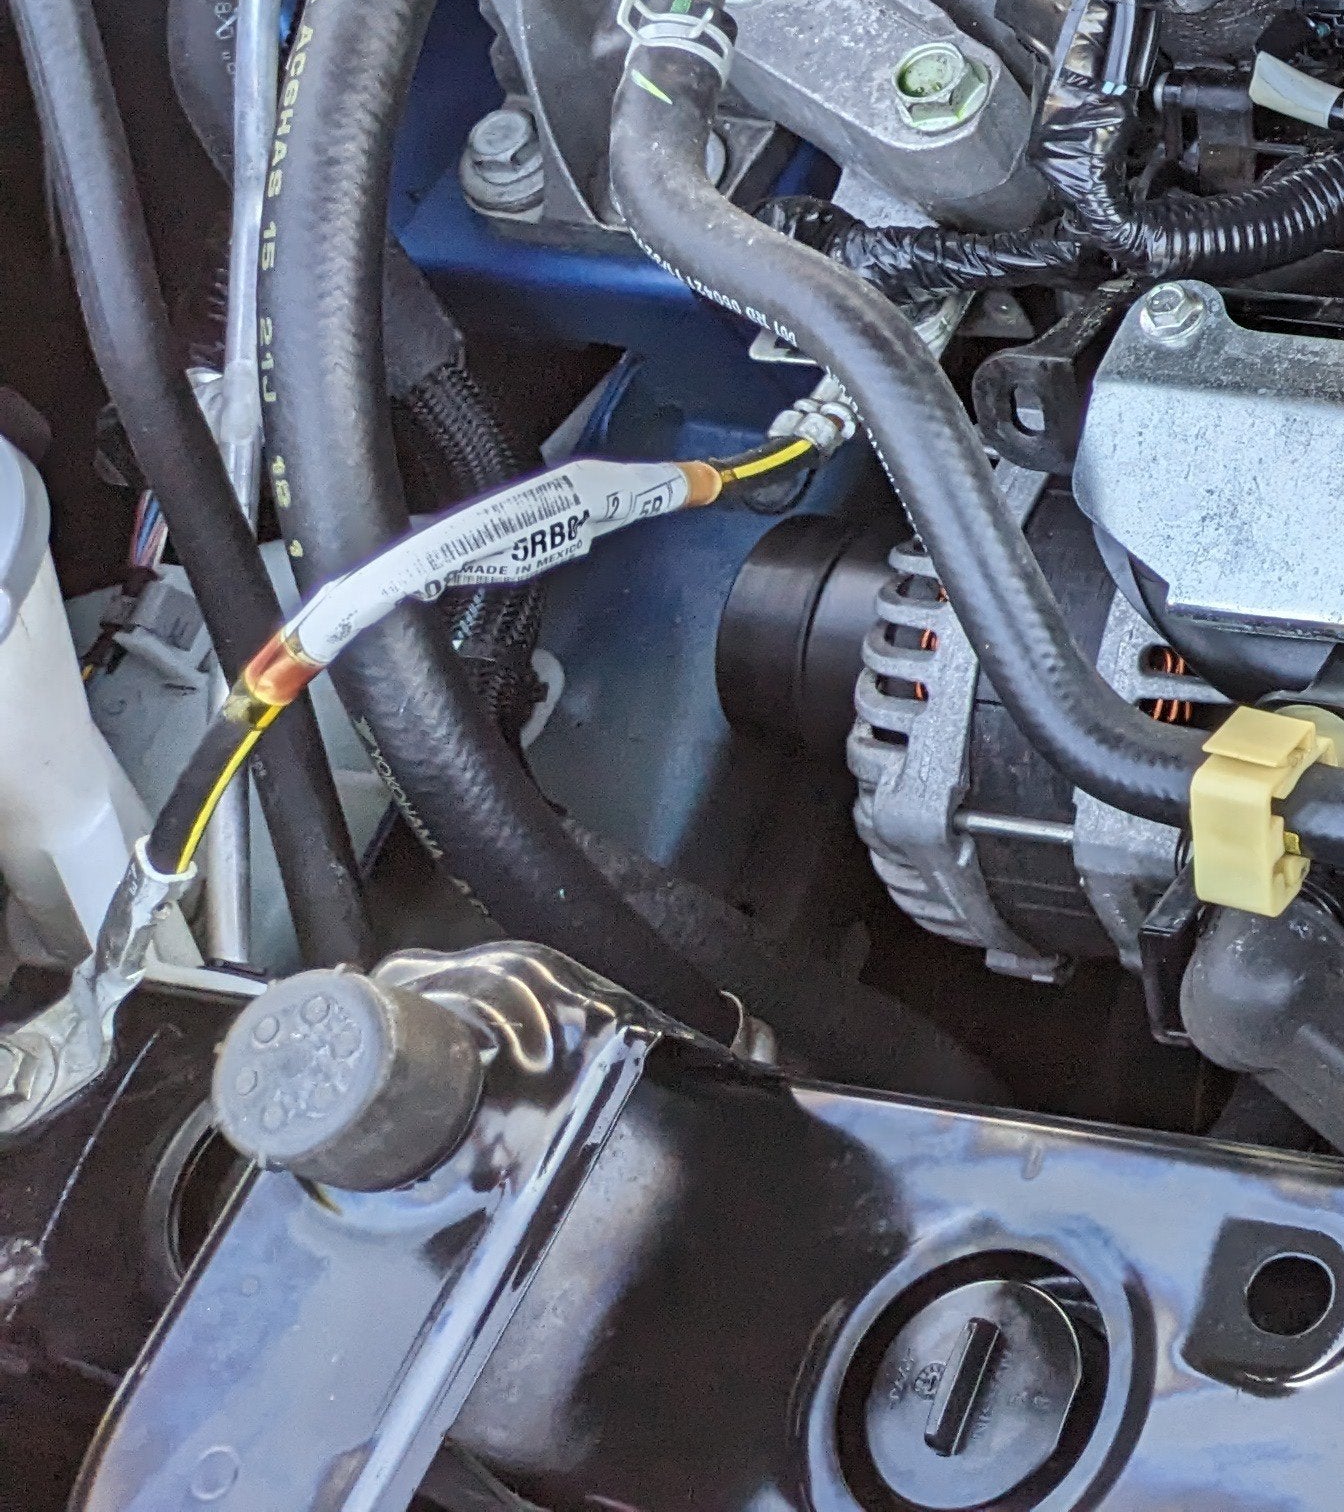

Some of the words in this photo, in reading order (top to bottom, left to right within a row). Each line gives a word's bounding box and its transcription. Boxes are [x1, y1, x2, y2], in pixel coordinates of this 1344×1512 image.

[460, 563, 508, 575] MADE
[515, 563, 532, 575] IN
[536, 539, 583, 569] MEXICO
